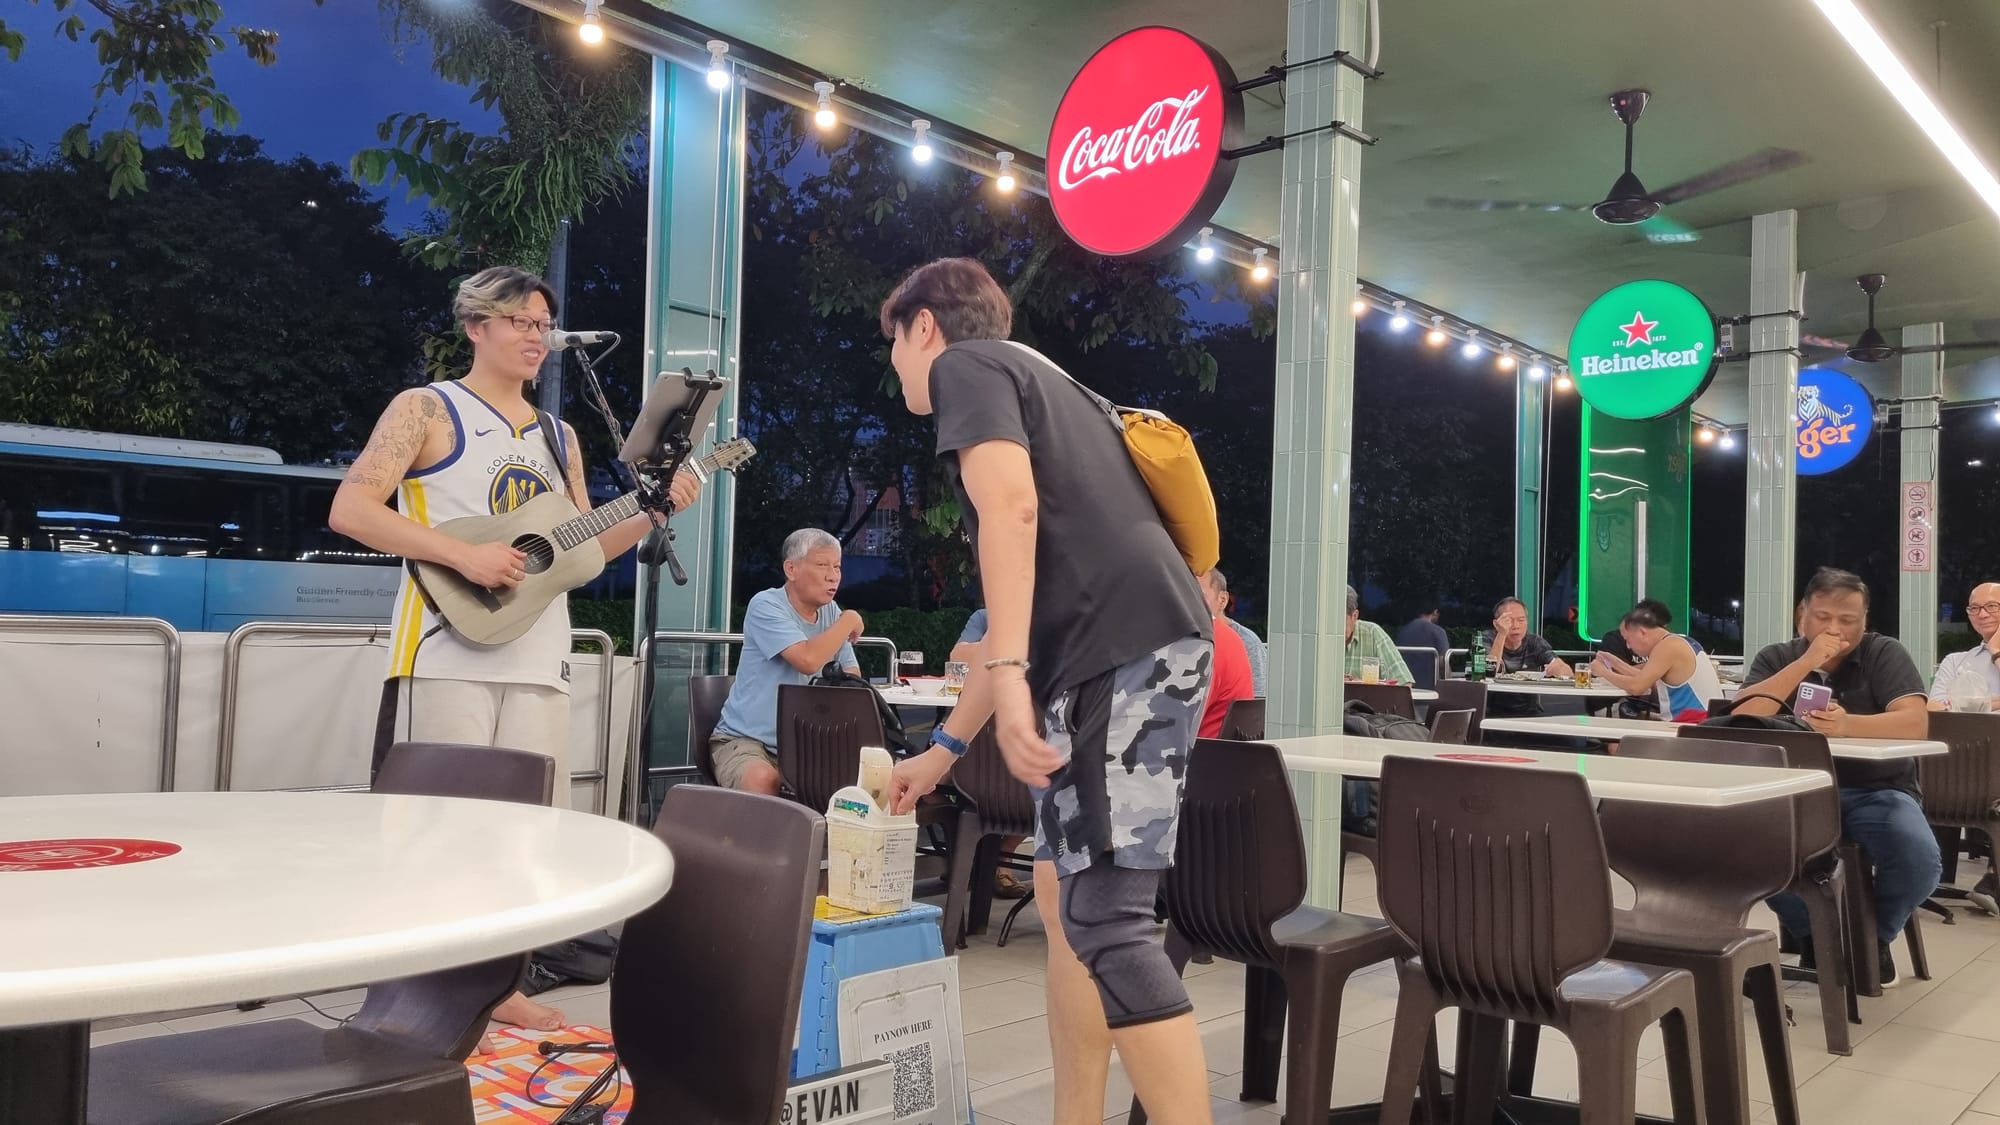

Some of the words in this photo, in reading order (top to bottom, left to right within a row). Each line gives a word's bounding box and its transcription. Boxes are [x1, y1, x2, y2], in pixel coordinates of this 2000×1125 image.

[1059, 85, 1209, 190] Coca-Cola
[1581, 348, 1699, 377] Heineken
[1796, 418, 1855, 457] ger
[486, 454, 525, 475] GOLEN
[529, 459, 555, 488] STA
[874, 1026, 910, 1044] PAYNOW
[910, 1019, 933, 1034] HERE
